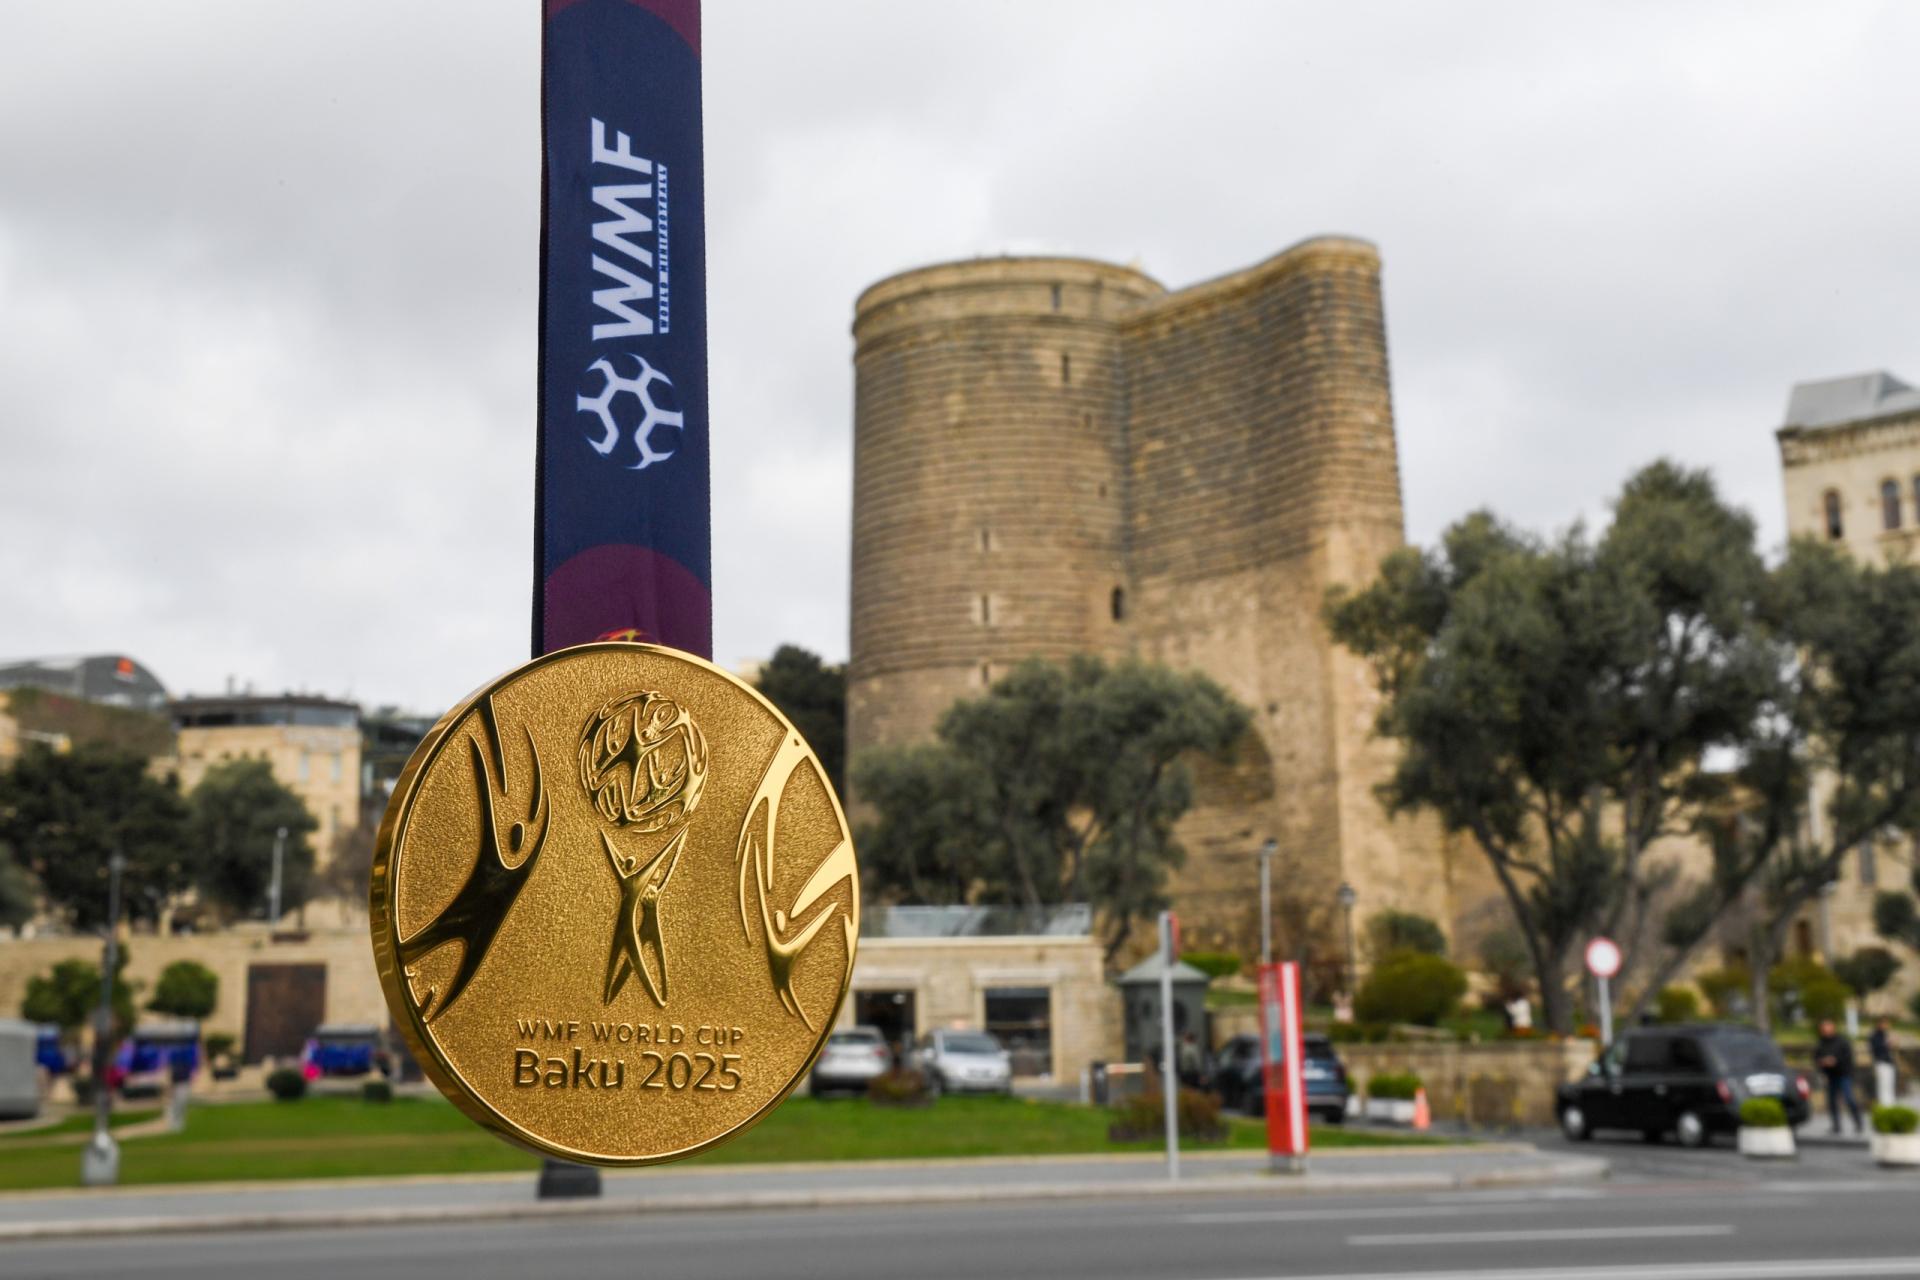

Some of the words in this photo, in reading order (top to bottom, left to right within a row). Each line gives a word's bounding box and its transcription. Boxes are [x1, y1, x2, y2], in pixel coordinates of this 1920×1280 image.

[592, 117, 653, 341] WMF
[657, 169, 669, 272] MINIFOOTBALL
[659, 282, 669, 328] WORLD
[516, 1019, 580, 1041] WMF
[591, 1022, 685, 1044] WORLD
[696, 1025, 744, 1046] CUP
[514, 1046, 625, 1089] Baku
[641, 1050, 742, 1091] 2025
